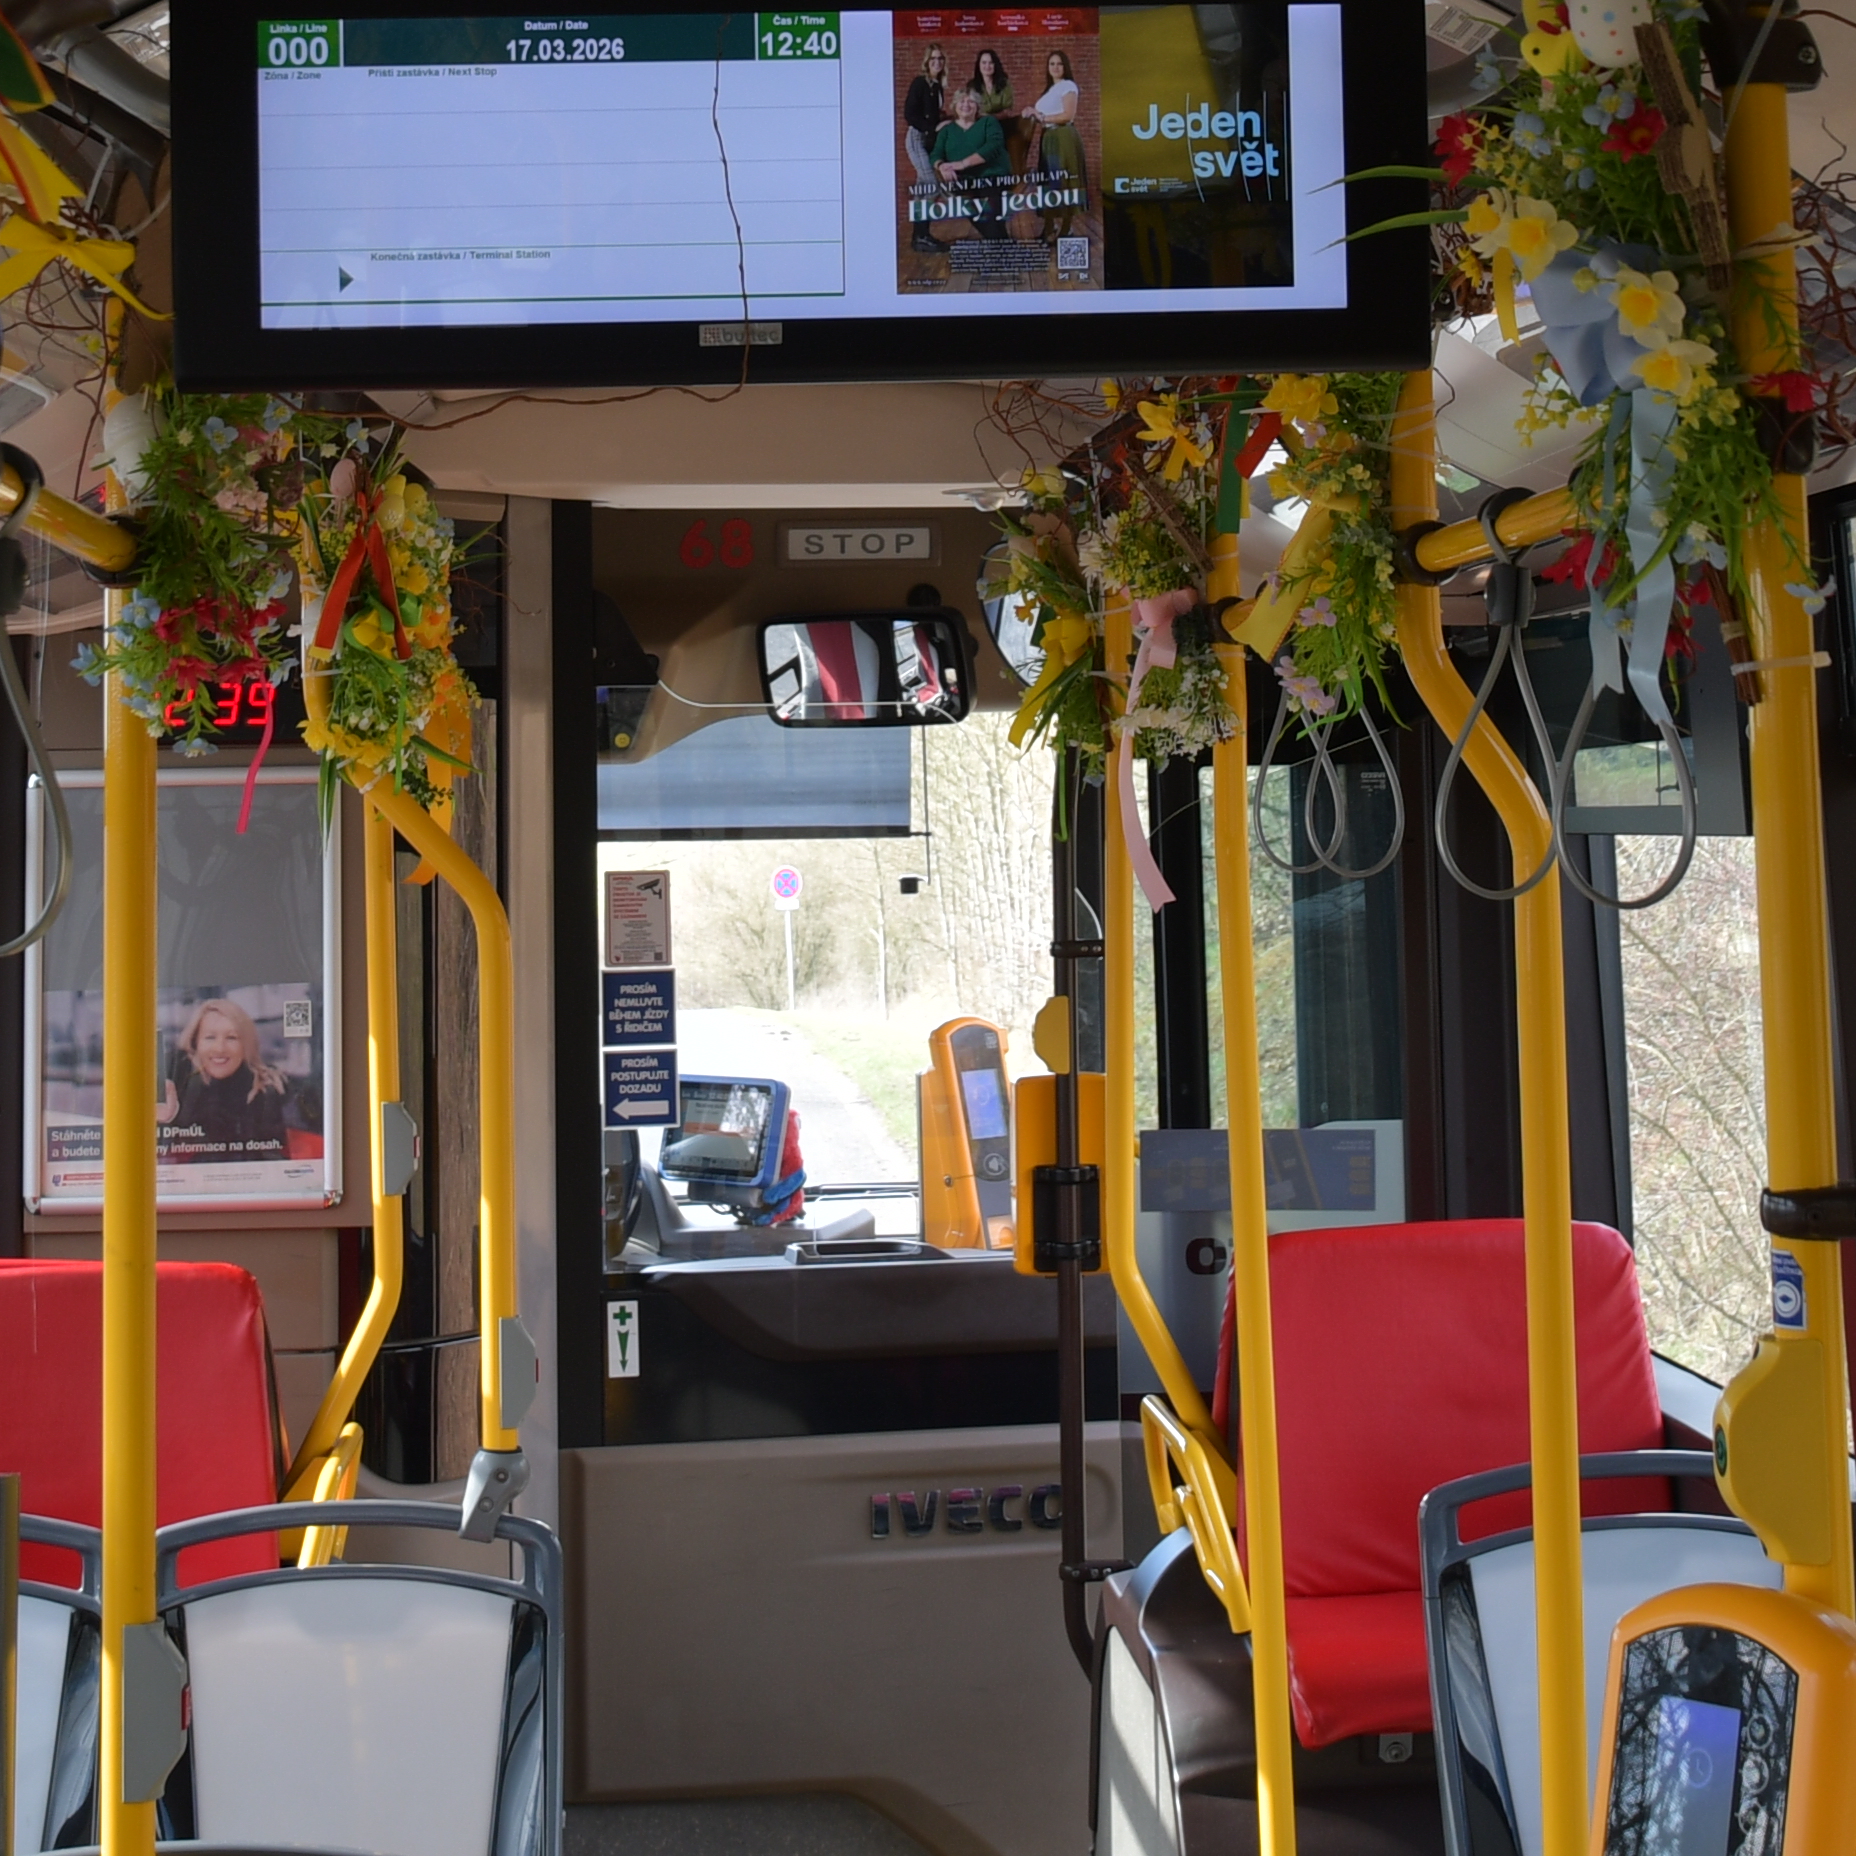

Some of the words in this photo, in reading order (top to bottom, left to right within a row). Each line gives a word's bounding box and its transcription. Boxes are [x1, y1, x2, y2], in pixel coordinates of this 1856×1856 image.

[524, 21, 557, 31] Datum
[565, 20, 589, 30] Date
[773, 14, 792, 25] Čas
[800, 15, 826, 25] Time
[270, 24, 297, 33] Linka
[305, 23, 327, 33] Line
[268, 36, 329, 66] 000
[506, 38, 625, 61] 17.03.2026
[761, 31, 837, 56] 12:40
[265, 71, 289, 80] Zóna
[297, 71, 322, 80] Zone
[397, 68, 440, 77] zastávka
[448, 67, 472, 76] Next
[474, 67, 497, 78] Stop
[1132, 102, 1261, 140] Jeden
[1194, 141, 1280, 178] svět
[908, 183, 937, 196] MHD
[971, 177, 993, 190] JEN
[997, 174, 1020, 187] PRO
[1130, 177, 1157, 186] Jeden
[908, 195, 989, 223] Holky
[995, 185, 1080, 221] jedou
[370, 251, 415, 261] Konečná
[417, 250, 461, 261] zastávka
[470, 250, 513, 260] Terminal
[515, 249, 551, 259] Station
[722, 327, 779, 343] butec
[679, 518, 755, 569] 68
[803, 533, 915, 555] STOP
[620, 982, 657, 995] PROSÍM
[614, 997, 663, 1008] NEMLUVTE
[608, 1009, 641, 1021] BĚHEM
[643, 1007, 670, 1020] JÍZDY
[615, 1023, 622, 1034] S
[624, 1021, 663, 1033] ŘIDIČEM
[621, 1055, 658, 1068] PROSÍM
[611, 1070, 670, 1082] POSTUPUJTE
[619, 1083, 662, 1095] DOZADU
[51, 1129, 101, 1142] Stáhněte
[163, 1123, 206, 1139] DPmÚL
[52, 1150, 59, 1158] a
[63, 1145, 101, 1158] budete
[171, 1141, 226, 1154] informace
[229, 1142, 243, 1152] na
[246, 1139, 284, 1151] dosah.
[871, 1483, 1063, 1540] IVECO
